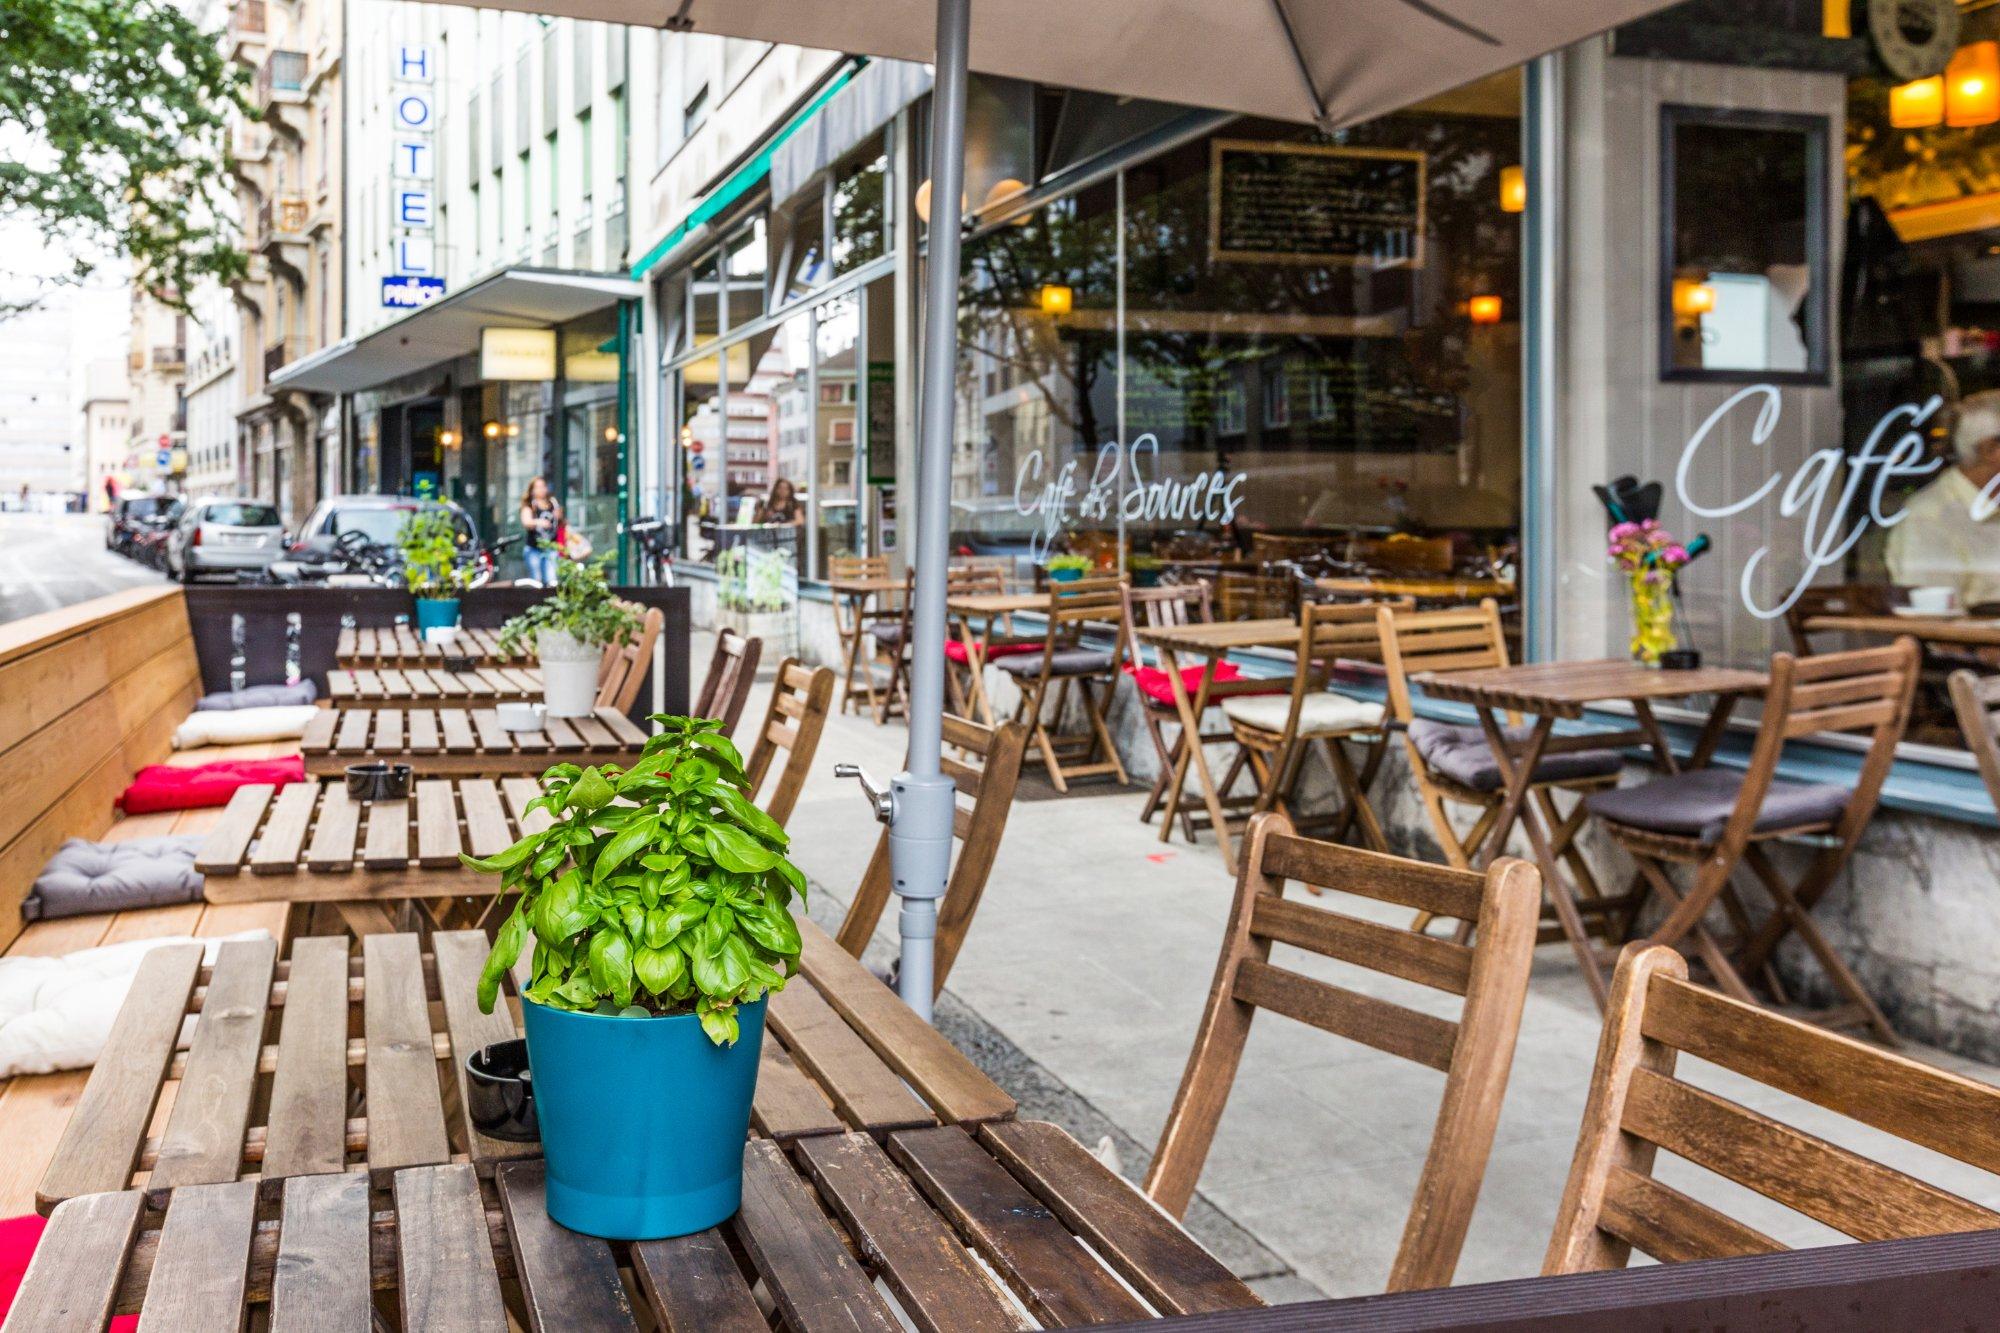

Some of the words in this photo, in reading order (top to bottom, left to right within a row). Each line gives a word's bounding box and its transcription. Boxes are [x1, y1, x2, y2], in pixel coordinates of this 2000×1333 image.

[400, 47, 428, 272] HOTEL
[1014, 449, 1078, 564] Café
[1117, 432, 1247, 525] Sources
[1676, 383, 1944, 619] Café
